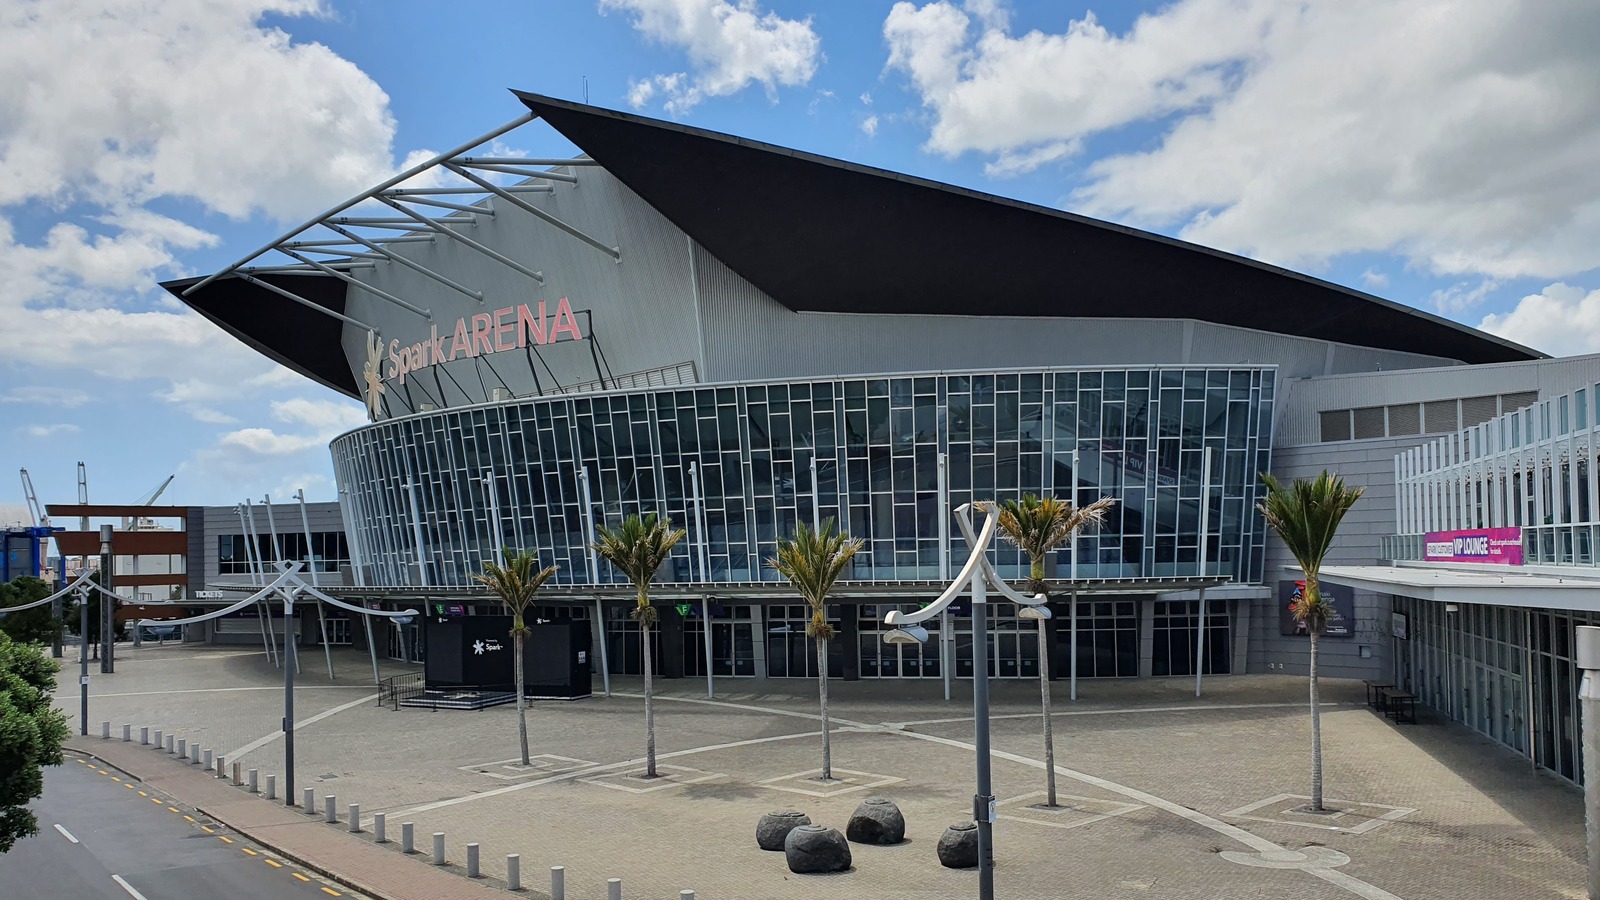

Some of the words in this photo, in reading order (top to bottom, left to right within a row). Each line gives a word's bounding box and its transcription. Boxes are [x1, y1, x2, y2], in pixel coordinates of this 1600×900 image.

[388, 324, 446, 385] Spark
[449, 296, 582, 361] ARENA
[1453, 538, 1463, 555] VIP
[1464, 537, 1488, 555] LOUNGE
[195, 590, 223, 598] TICKETS
